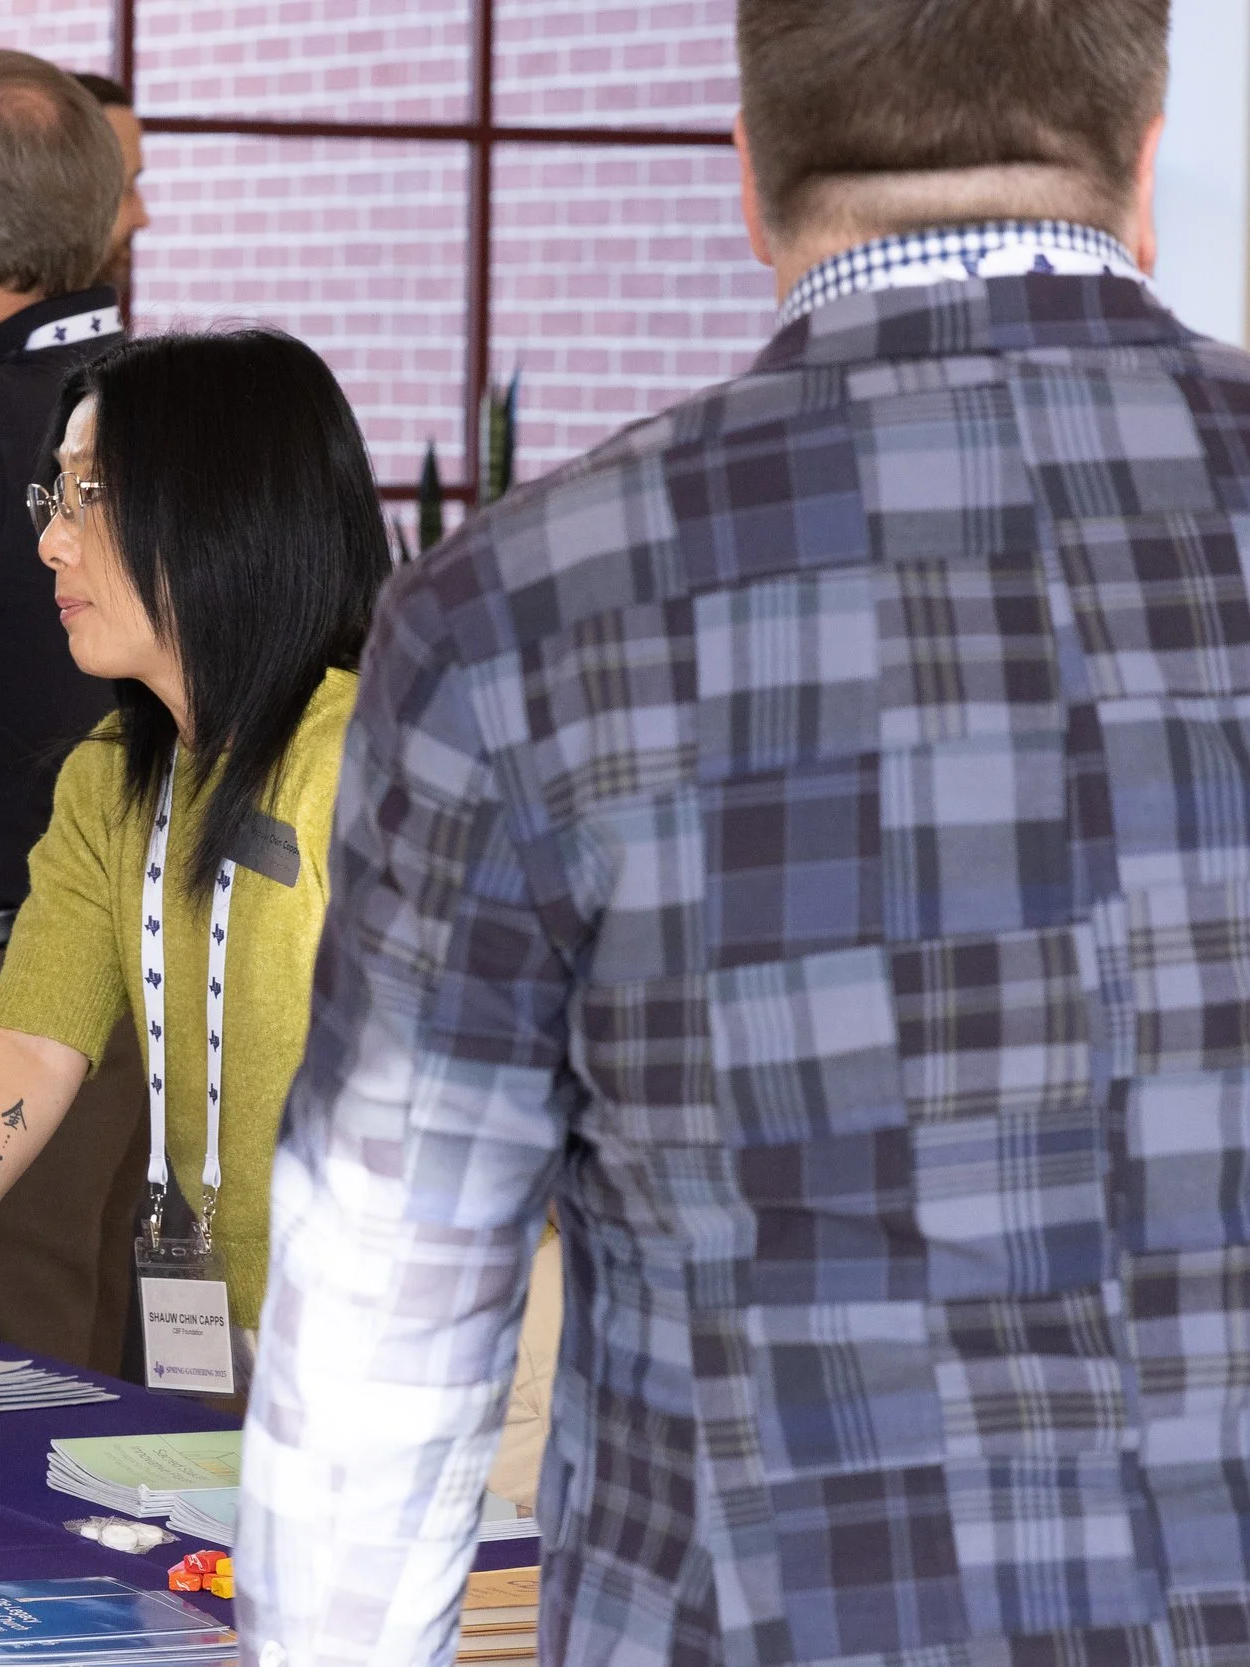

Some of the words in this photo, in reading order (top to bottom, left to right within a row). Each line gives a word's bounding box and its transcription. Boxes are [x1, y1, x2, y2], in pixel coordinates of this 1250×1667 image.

[149, 1311, 178, 1324] SHAUW
[179, 1313, 198, 1325] CHIN
[199, 1315, 225, 1327] CAPPS
[172, 1327, 182, 1335] CBF
[182, 1328, 204, 1336] Foundation
[166, 1366, 184, 1375] SPRING
[184, 1367, 214, 1377] GATHERING
[214, 1370, 227, 1378] 2025
[4, 1606, 43, 1623] Legacy
